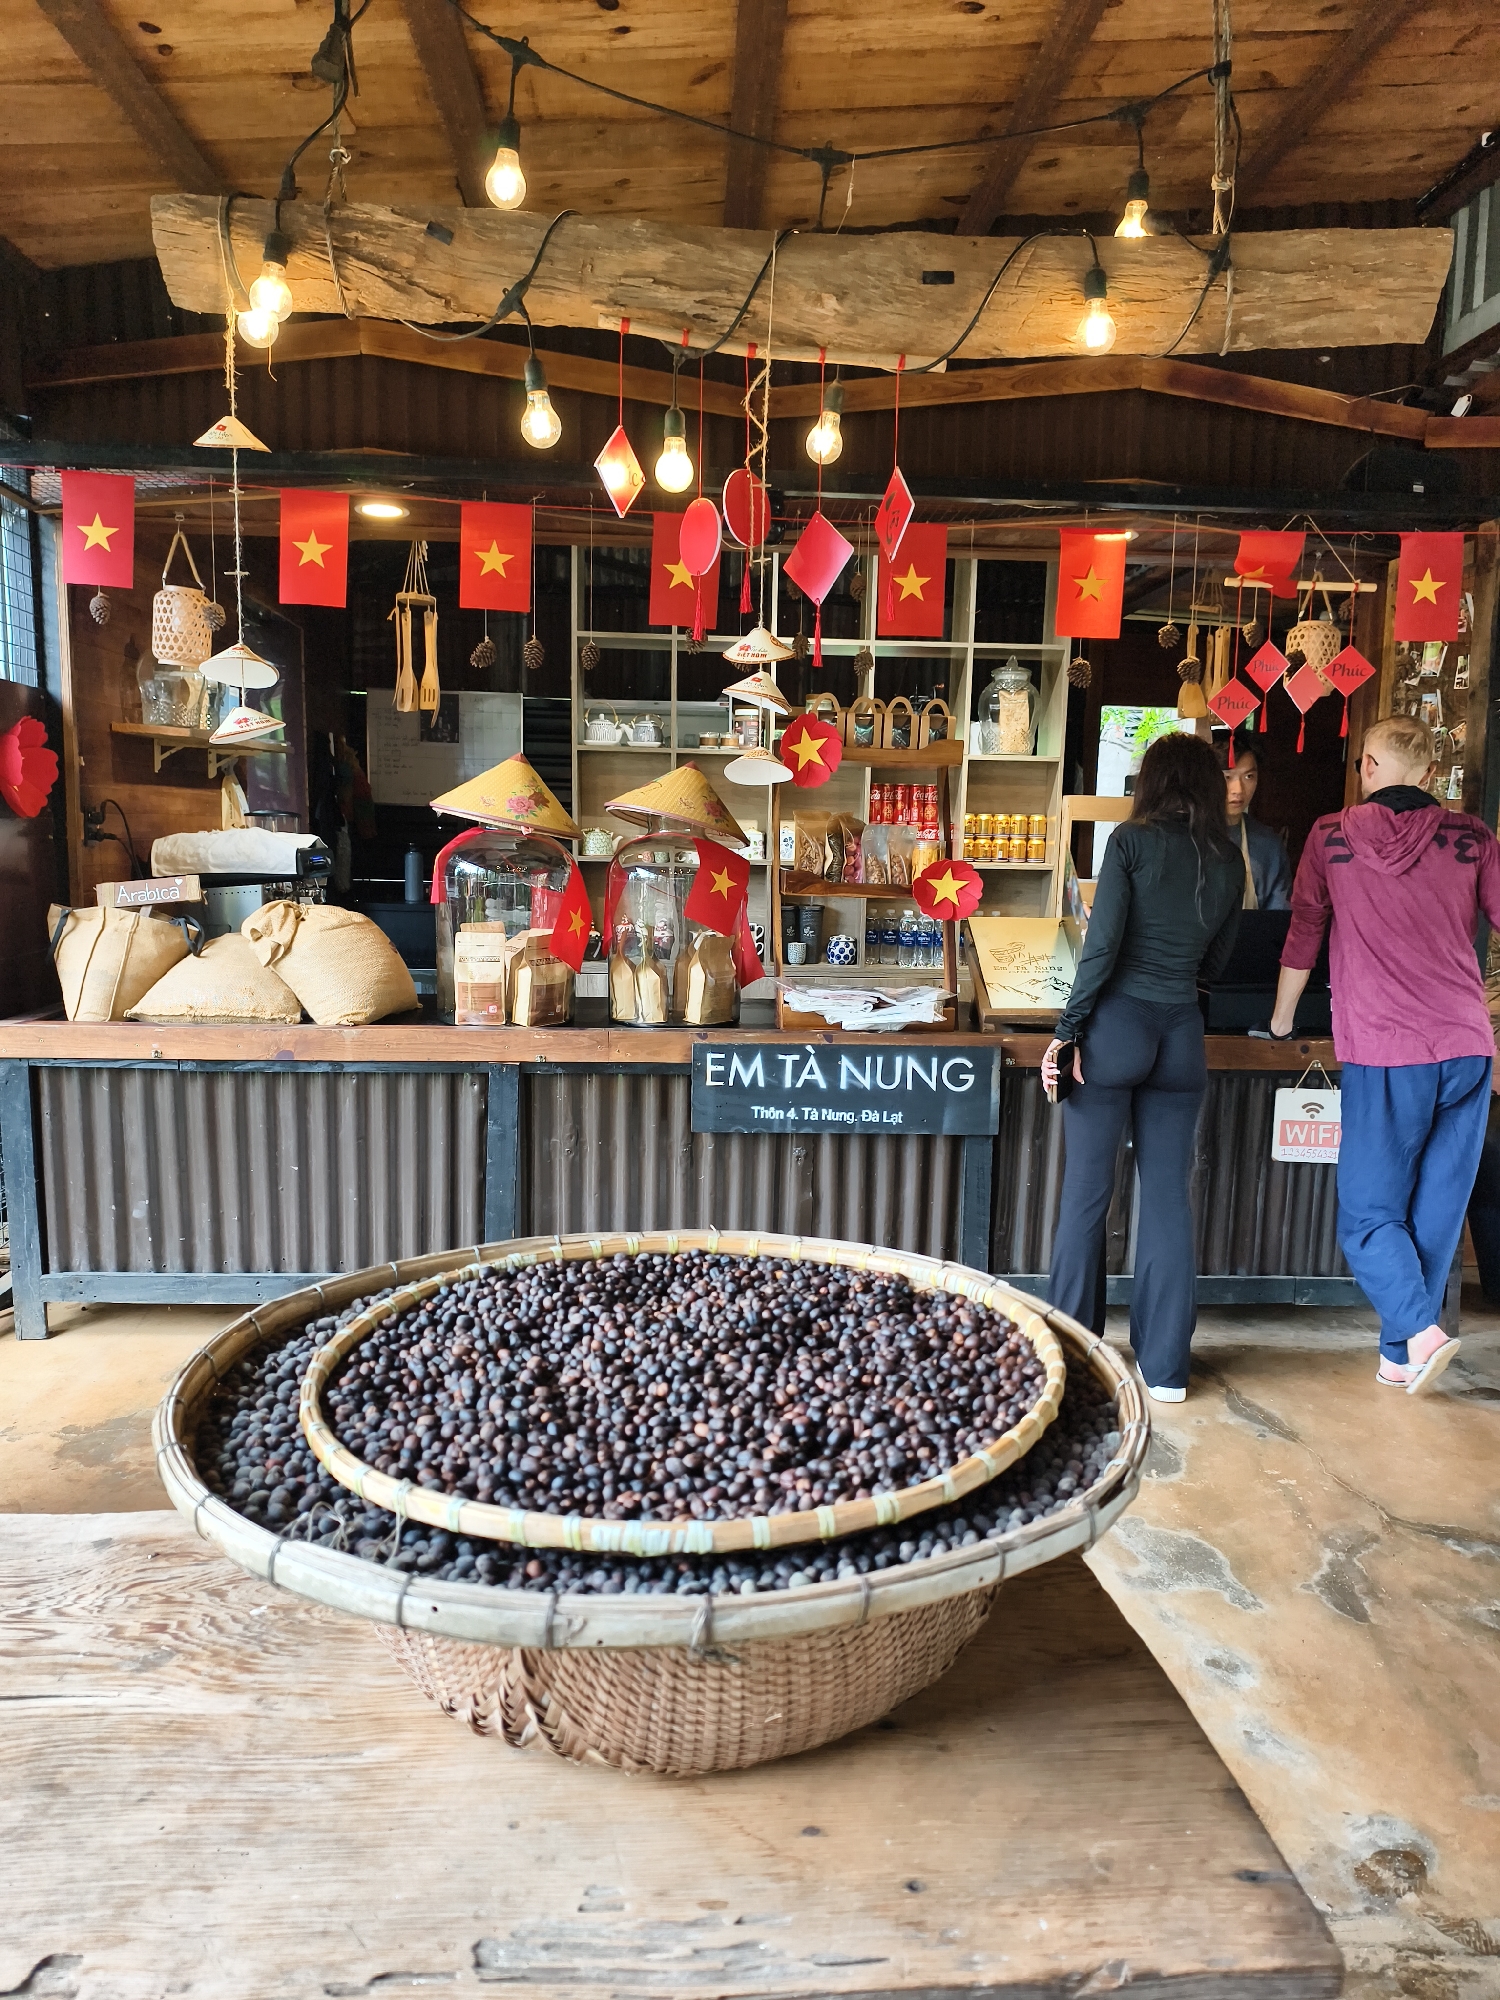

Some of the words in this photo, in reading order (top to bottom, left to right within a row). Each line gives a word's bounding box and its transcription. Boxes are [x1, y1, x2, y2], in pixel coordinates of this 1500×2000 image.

[1331, 663, 1369, 677] Phúc
[1217, 696, 1251, 710] Phúc
[116, 882, 180, 903] Arabica
[705, 1052, 765, 1088] EM
[778, 1044, 827, 1089] TÀ
[839, 1054, 976, 1092] NUNG
[751, 1105, 784, 1120] Thôn
[801, 1107, 819, 1121] Tà
[861, 1110, 880, 1123] Đà
[882, 1112, 903, 1125] Lạt
[1285, 1123, 1340, 1146] WiFi
